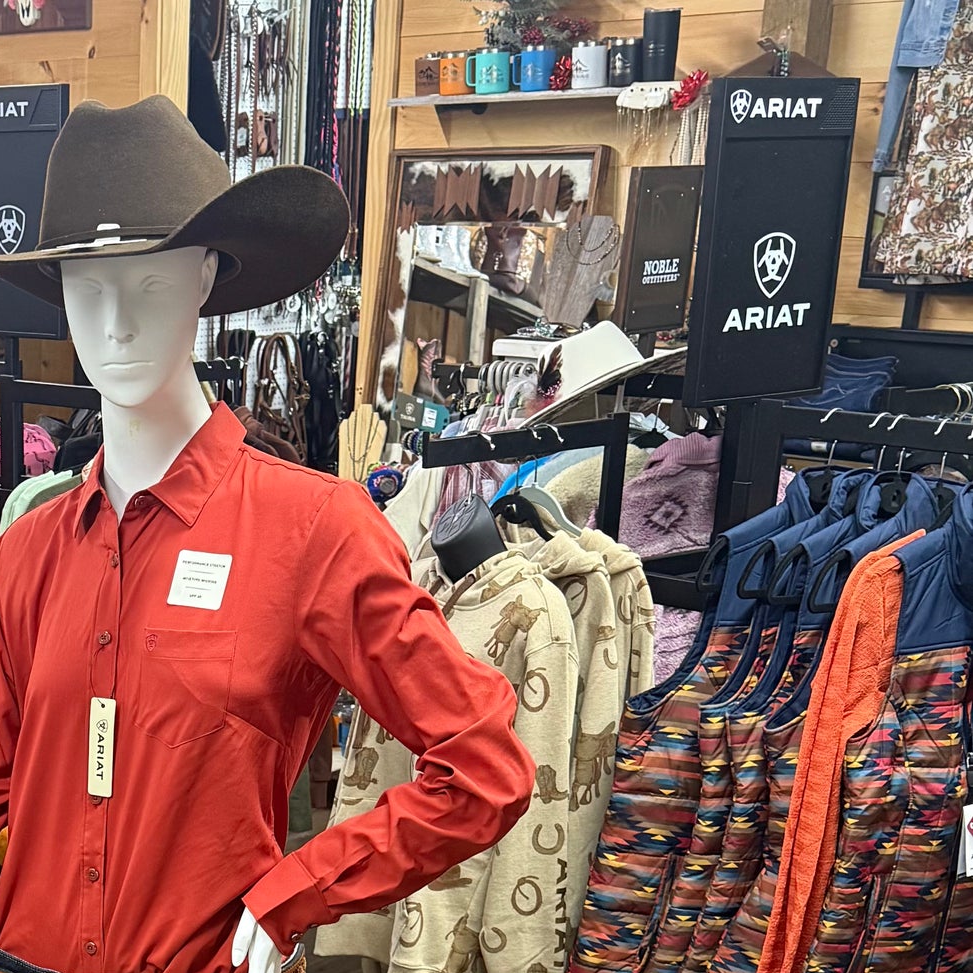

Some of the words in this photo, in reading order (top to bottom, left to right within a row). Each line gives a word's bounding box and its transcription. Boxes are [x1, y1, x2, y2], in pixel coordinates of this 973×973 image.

[749, 97, 823, 119] ARIAT
[642, 258, 680, 276] NOBLE
[722, 302, 811, 333] ARIAT
[95, 733, 106, 781] ARIAT
